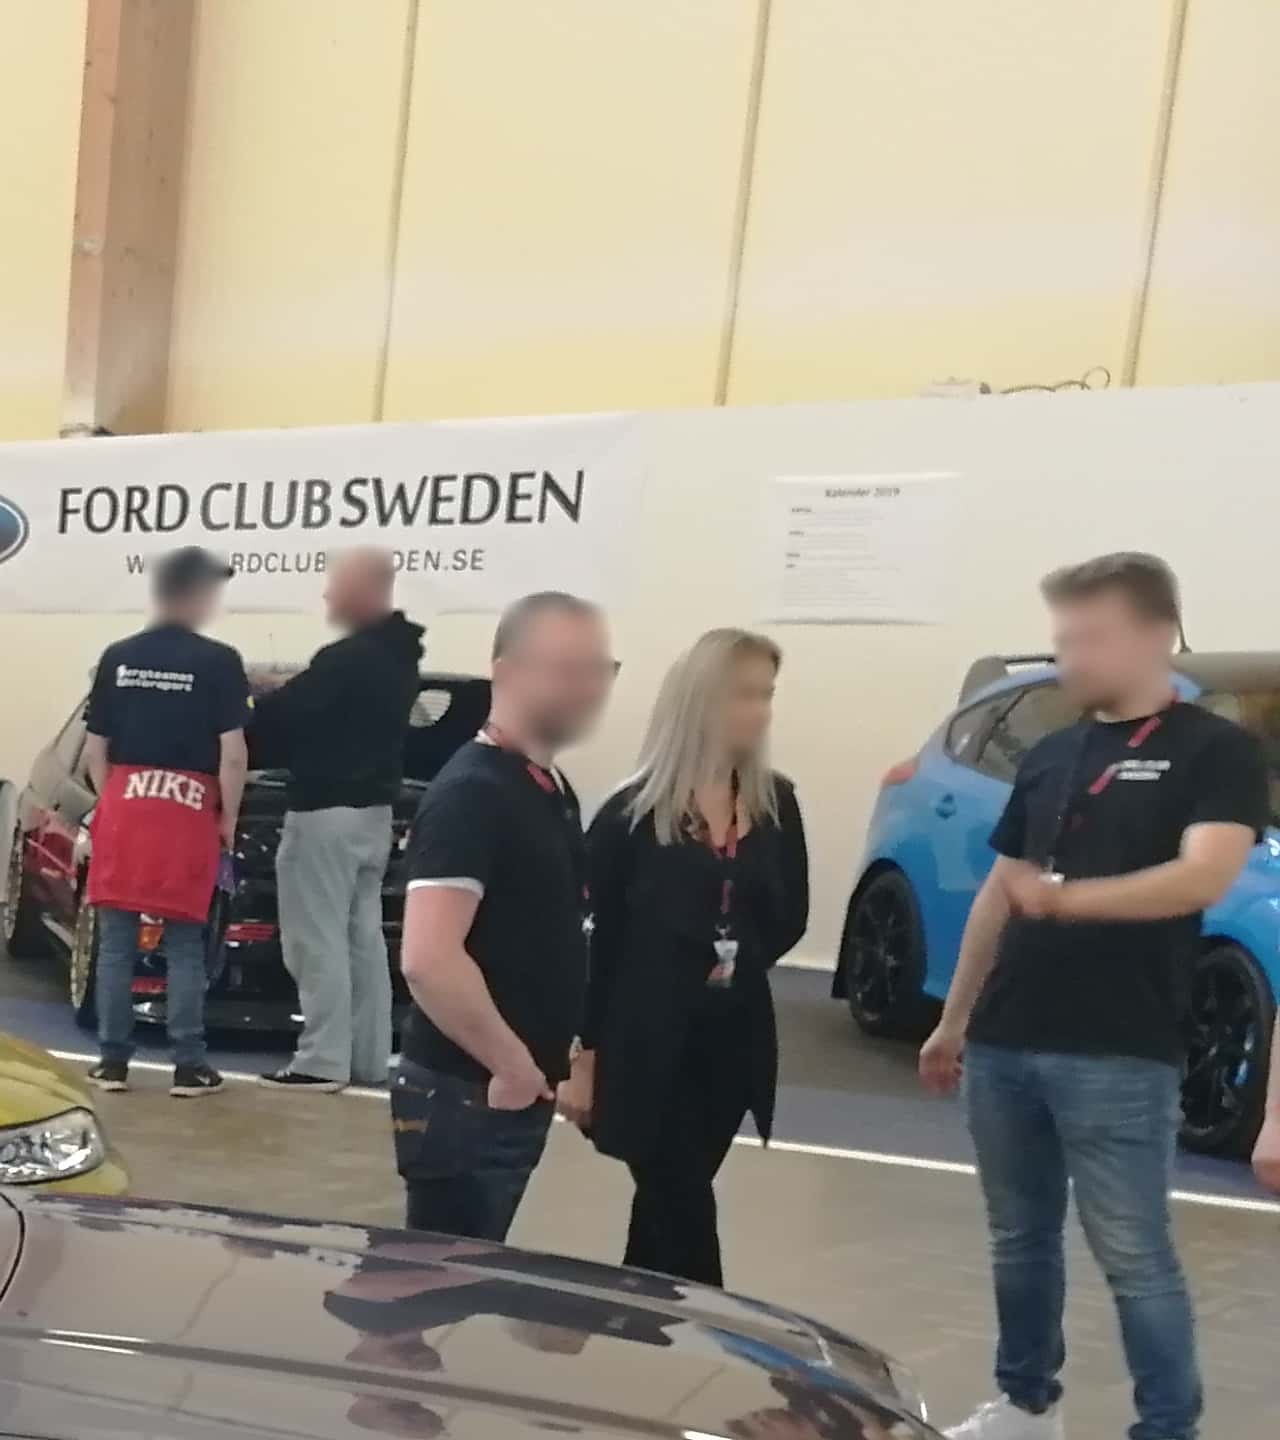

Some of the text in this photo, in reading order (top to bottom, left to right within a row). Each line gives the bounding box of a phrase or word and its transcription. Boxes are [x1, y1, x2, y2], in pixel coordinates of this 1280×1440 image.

[57, 469, 585, 535] FORD CLUB SWEDEN
[123, 769, 207, 811] NIKE
